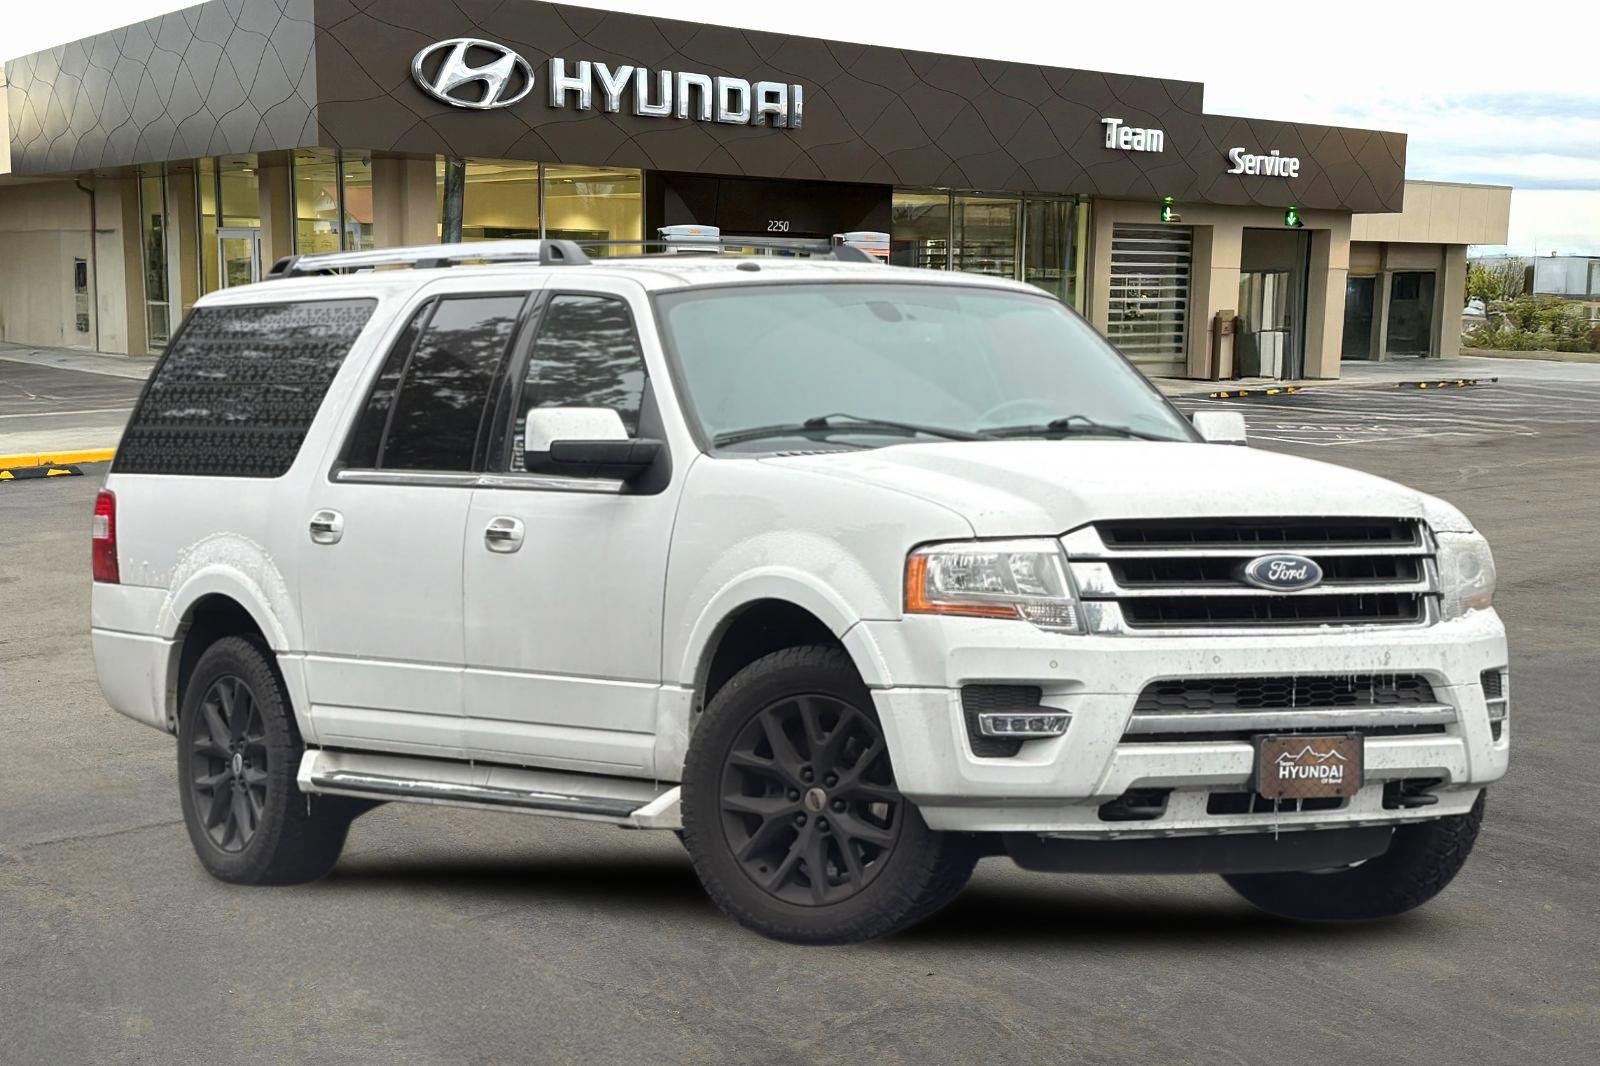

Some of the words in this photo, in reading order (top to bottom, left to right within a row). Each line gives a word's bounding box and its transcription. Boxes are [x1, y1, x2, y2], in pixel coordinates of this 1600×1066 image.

[549, 57, 803, 128] HYUNDAI
[1101, 117, 1164, 152] Team
[1227, 147, 1300, 178] Service
[767, 219, 790, 232] 2250
[1267, 560, 1308, 581] Ford
[1279, 764, 1344, 779] HYUNDAI
